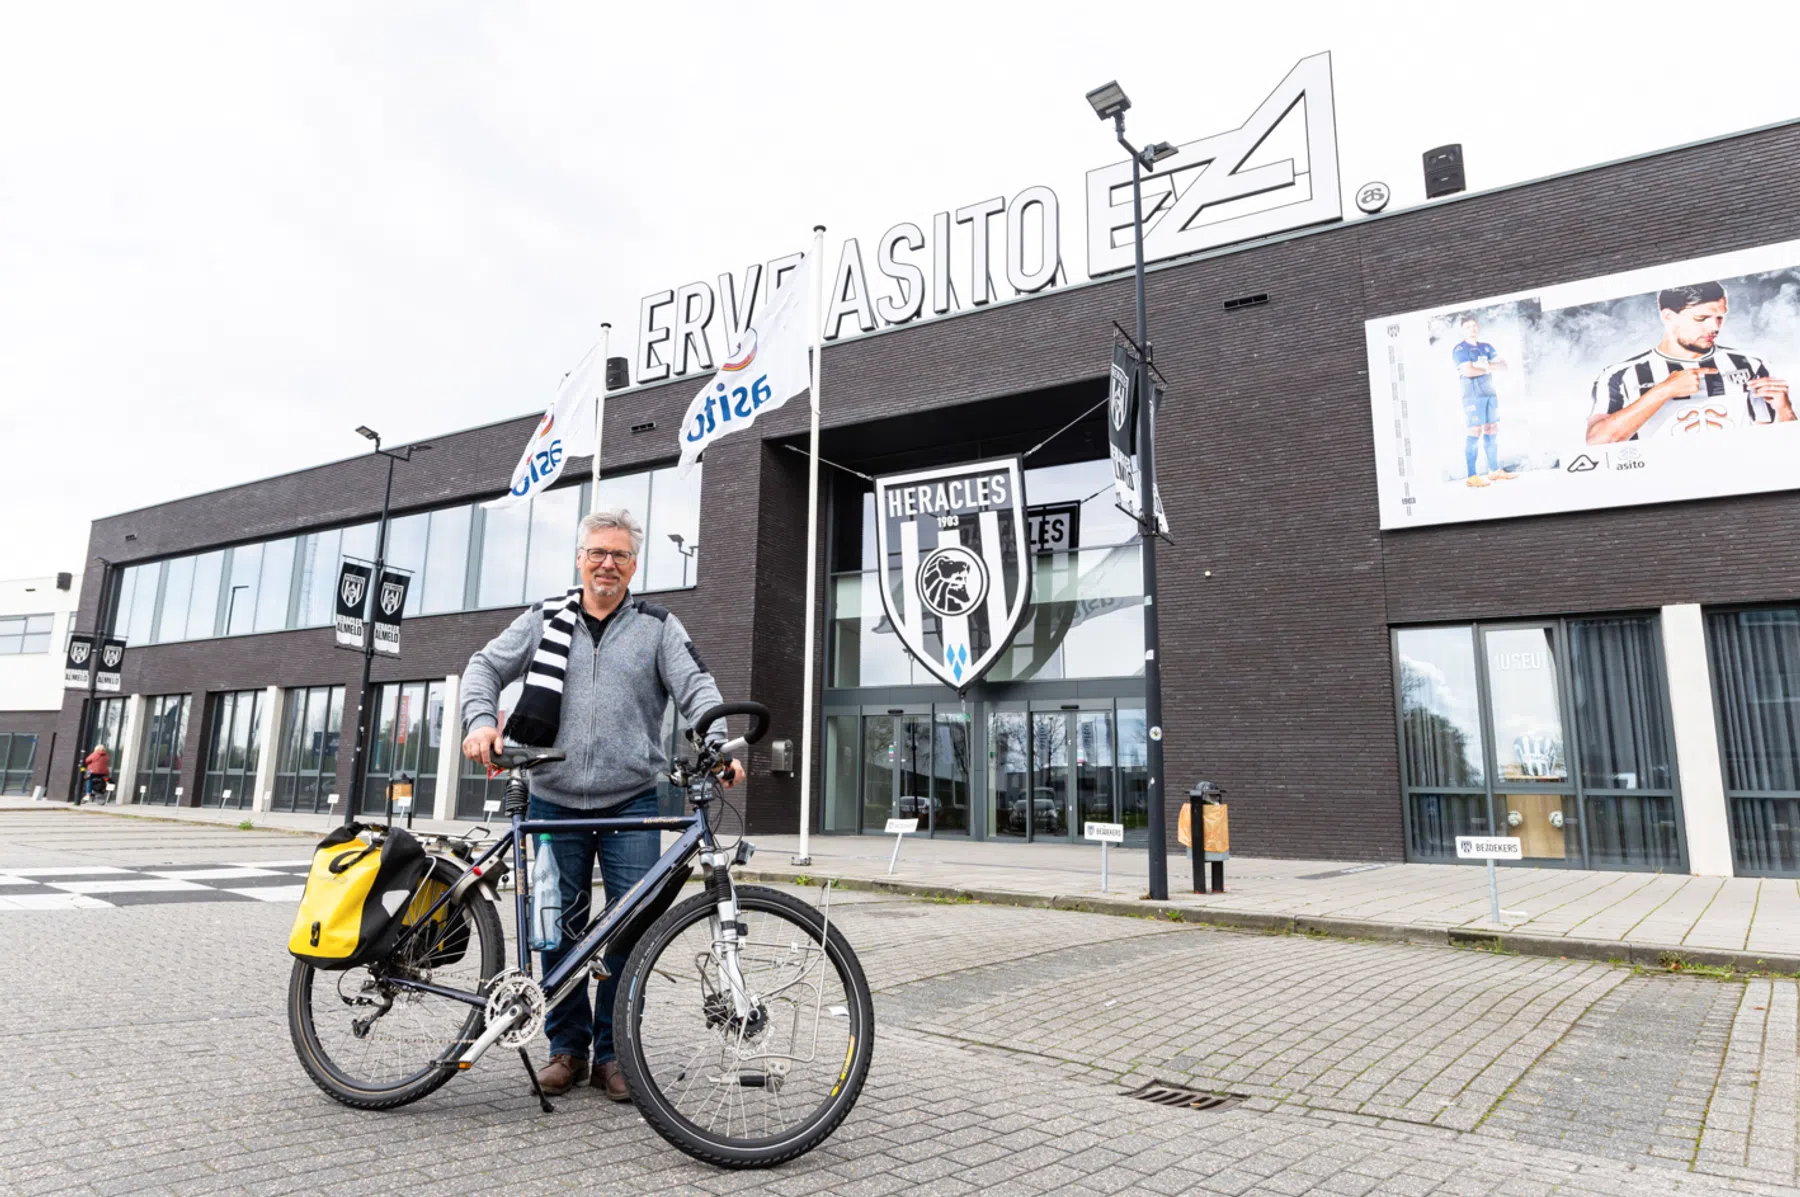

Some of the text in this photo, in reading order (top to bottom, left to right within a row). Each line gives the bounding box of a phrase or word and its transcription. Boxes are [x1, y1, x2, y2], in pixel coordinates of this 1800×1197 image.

[823, 185, 1061, 341] ASITO
[1616, 460, 1645, 471] asito
[888, 476, 1007, 518] HERACLES
[937, 515, 960, 528] 1903
[337, 621, 362, 636] ALMELO
[375, 629, 399, 643] ALMELO
[65, 673, 88, 682] ALMELO
[97, 676, 119, 685] ALMELO
[1475, 843, 1518, 853] BEZOEKERS
